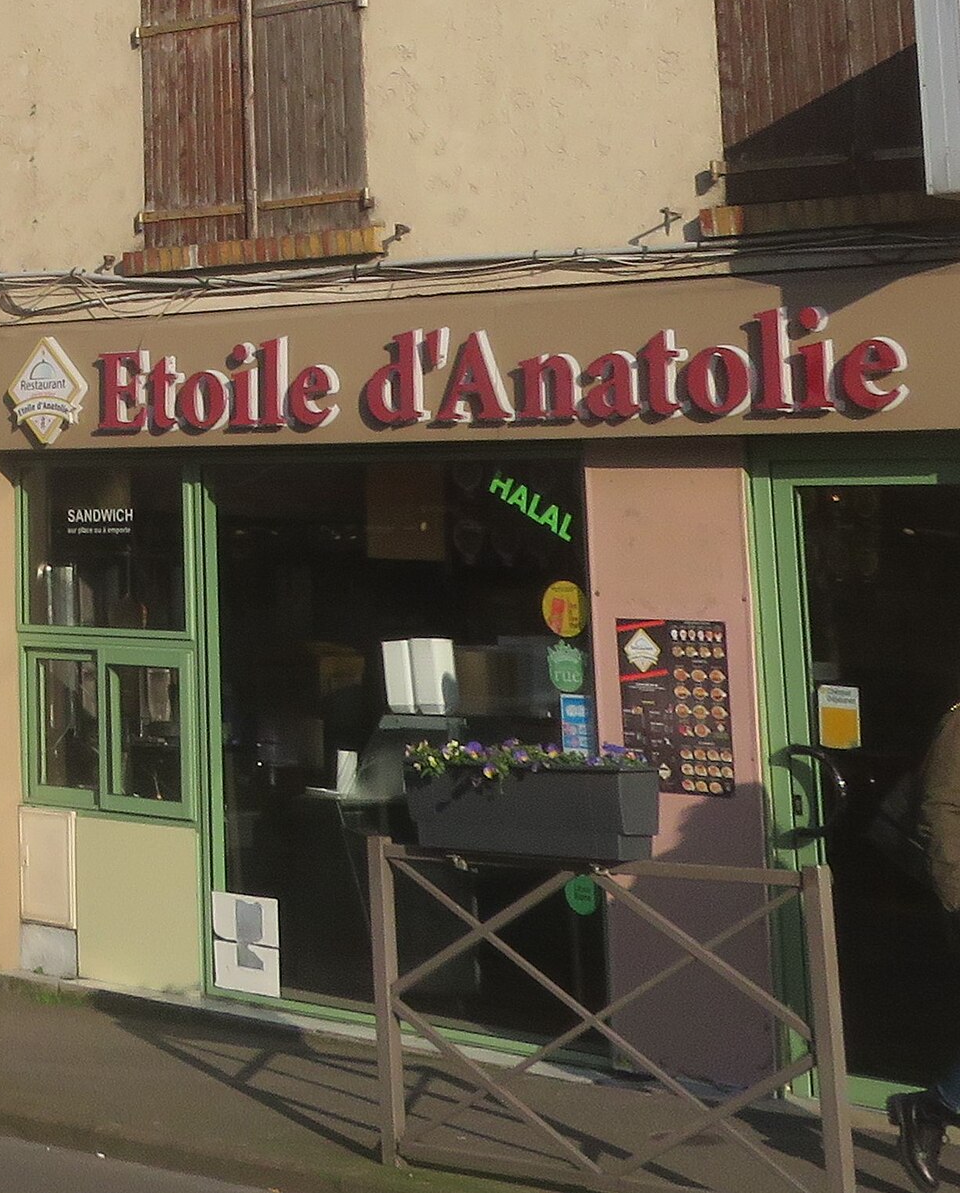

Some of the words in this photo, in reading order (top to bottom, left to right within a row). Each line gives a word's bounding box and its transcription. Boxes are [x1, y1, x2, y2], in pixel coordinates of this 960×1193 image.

[20, 378, 66, 391] Restaurant
[95, 335, 340, 431] Etoile
[366, 307, 909, 423] d'Anatolie
[67, 508, 134, 523] SANDWICH
[489, 472, 572, 542] HALAL
